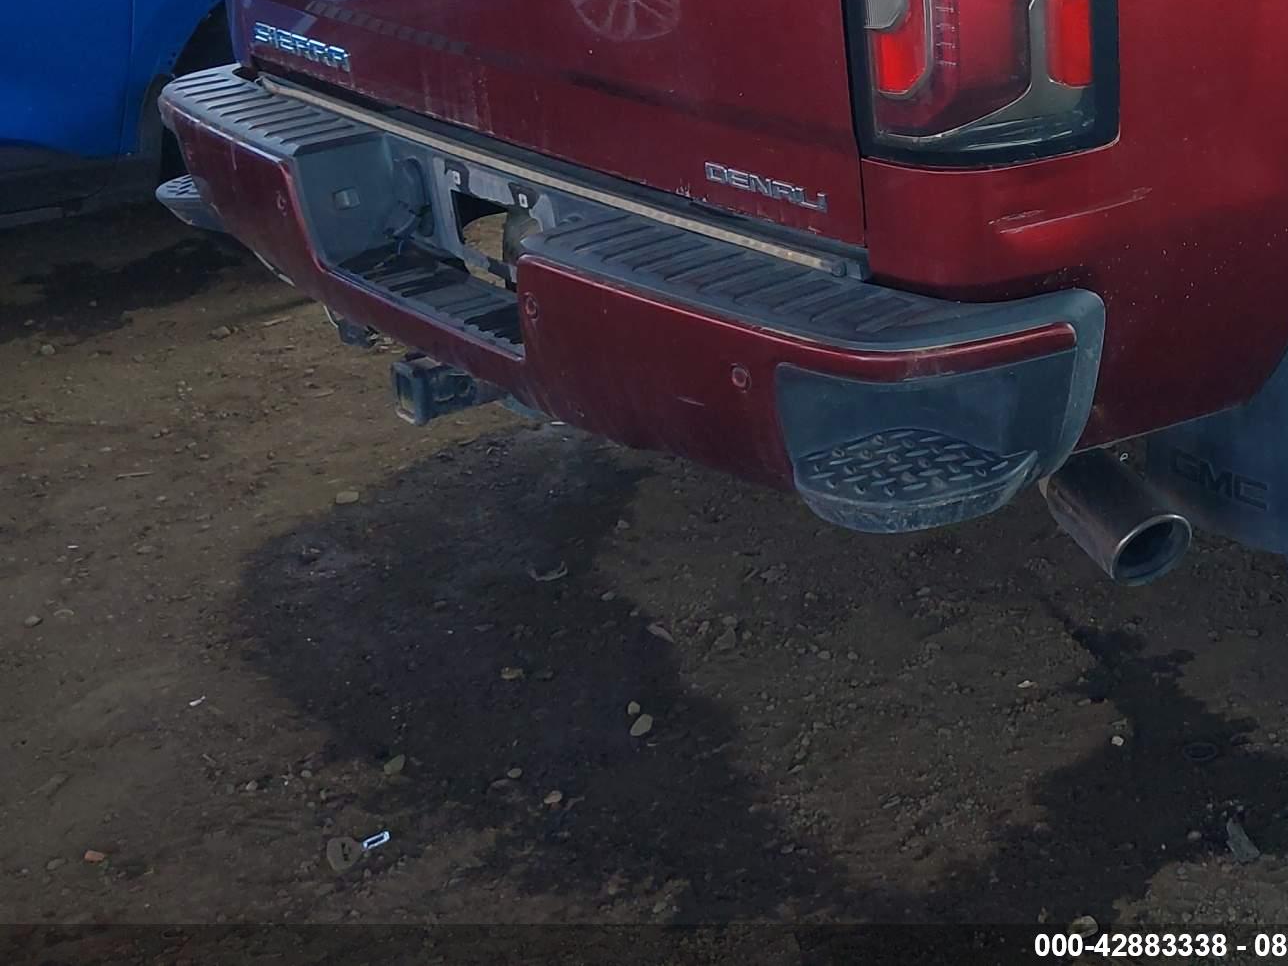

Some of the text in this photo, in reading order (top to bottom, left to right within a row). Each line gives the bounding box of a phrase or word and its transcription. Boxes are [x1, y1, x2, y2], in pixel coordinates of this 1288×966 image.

[254, 21, 351, 73] SIERRA
[705, 161, 828, 214] DENALI
[1170, 447, 1271, 512] GMC
